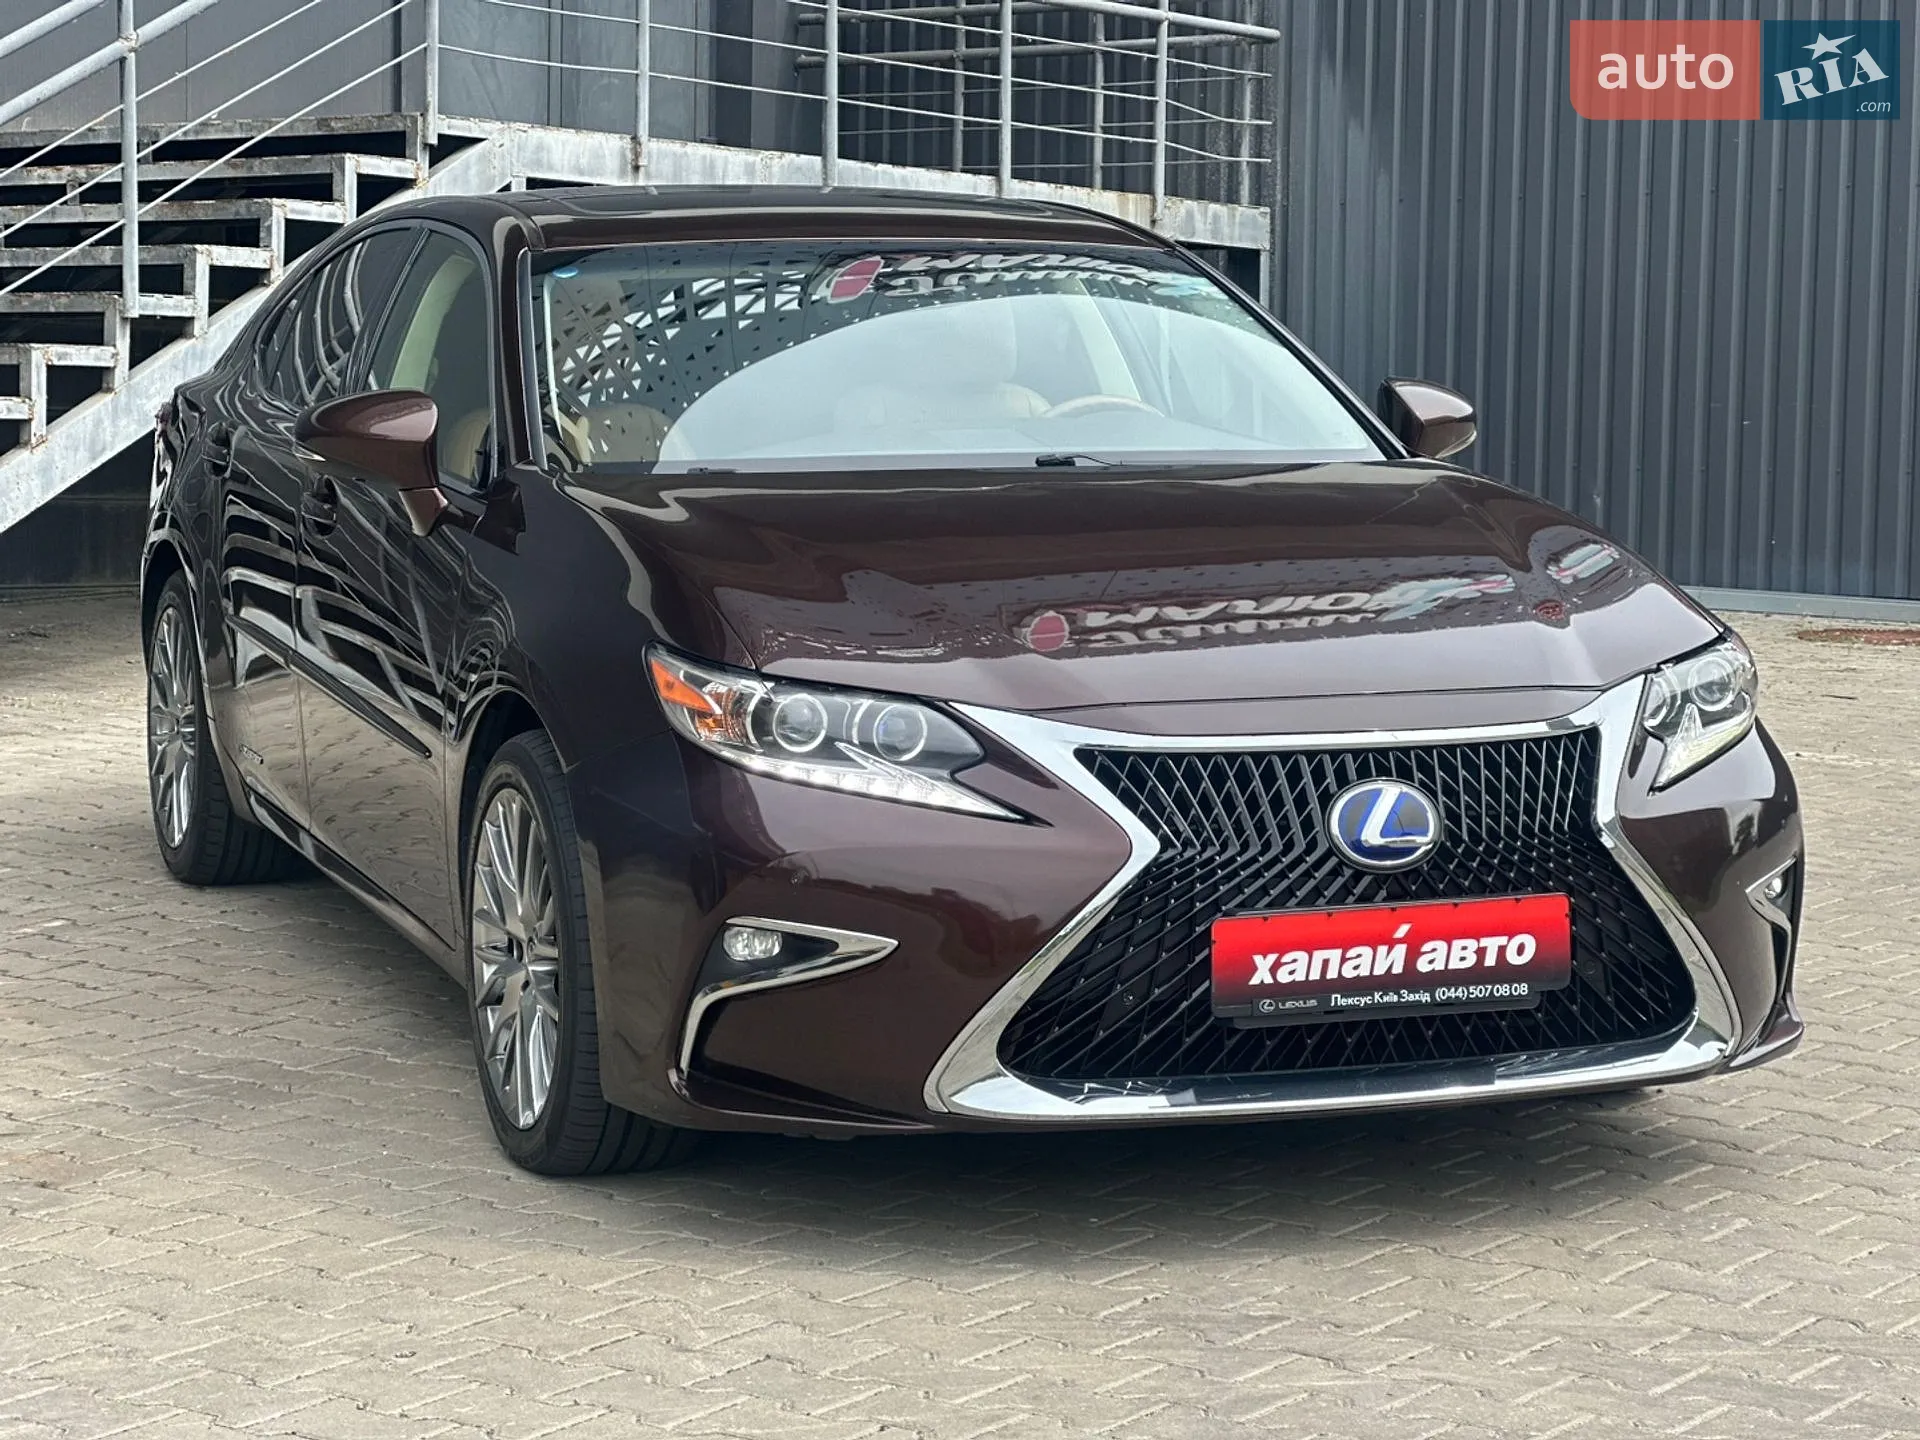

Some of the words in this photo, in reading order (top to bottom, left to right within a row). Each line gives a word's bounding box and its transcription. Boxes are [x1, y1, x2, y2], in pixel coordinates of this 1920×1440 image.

[1416, 933, 1537, 973] авто
[1330, 994, 1373, 1007] Лексус
[1374, 990, 1399, 1004] Київ
[1400, 989, 1431, 1003] Захід
